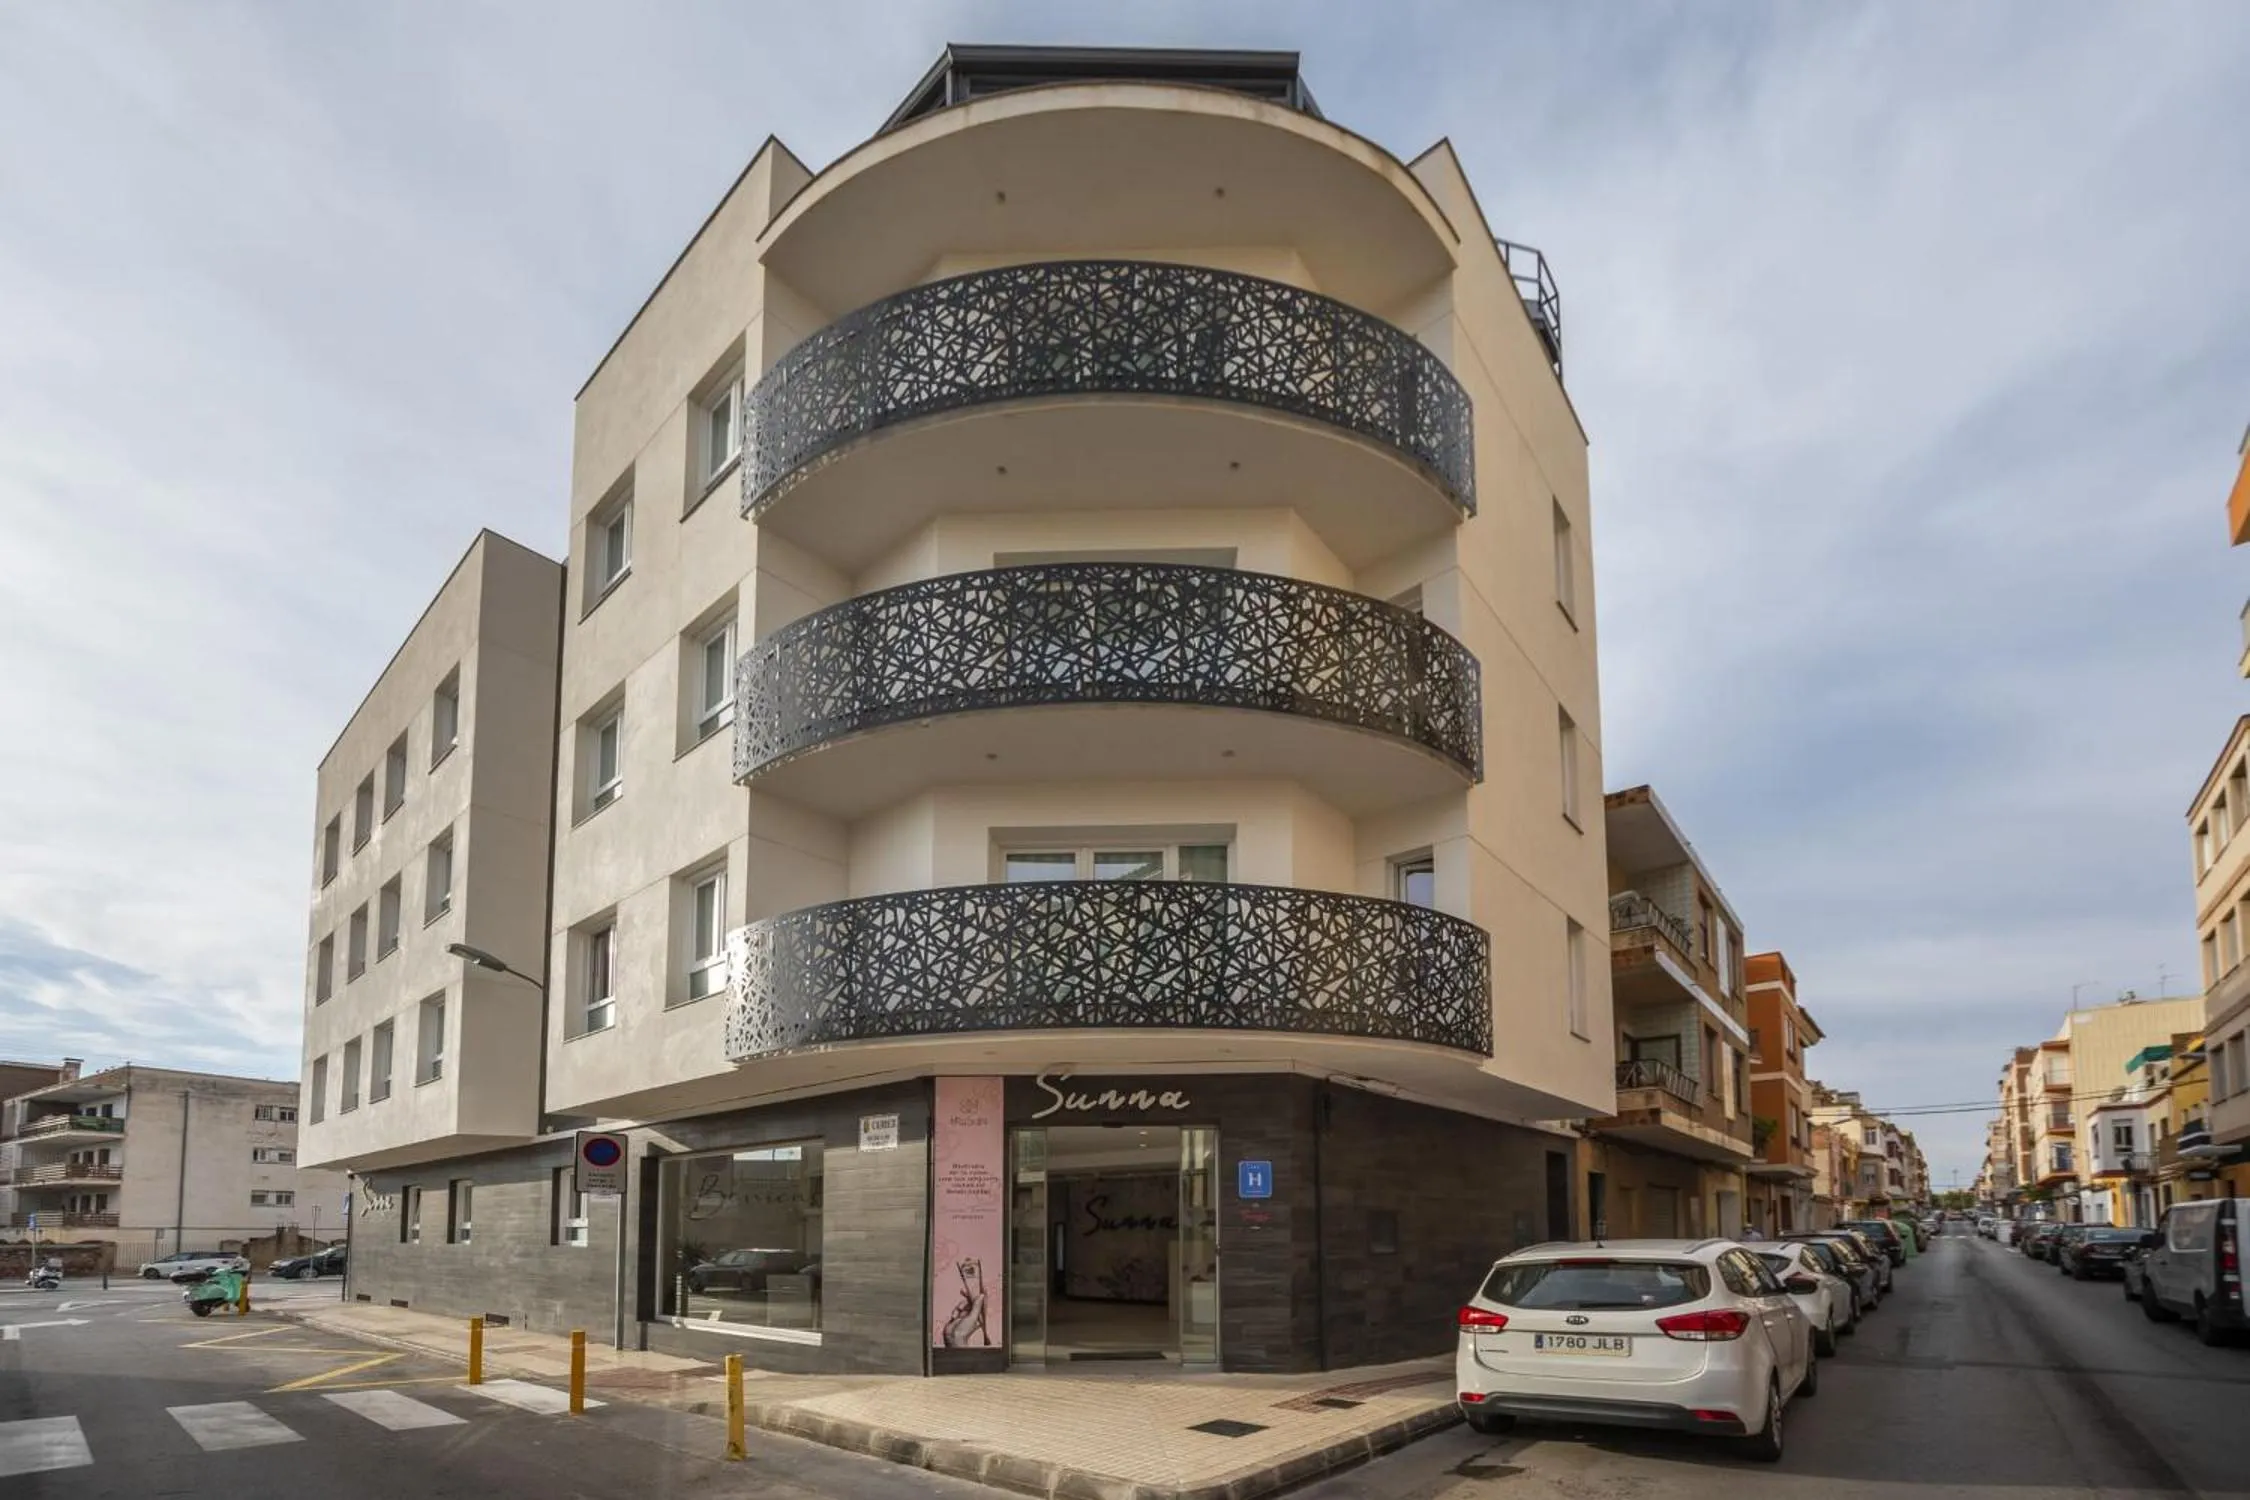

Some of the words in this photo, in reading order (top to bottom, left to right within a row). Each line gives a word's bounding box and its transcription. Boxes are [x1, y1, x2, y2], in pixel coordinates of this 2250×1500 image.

[1031, 1063, 1191, 1119] Sunna
[1247, 1172, 1262, 1187] H
[1082, 1194, 1179, 1236] Sunna
[1548, 1335, 1586, 1349] 1780
[1592, 1337, 1624, 1351] JLB
